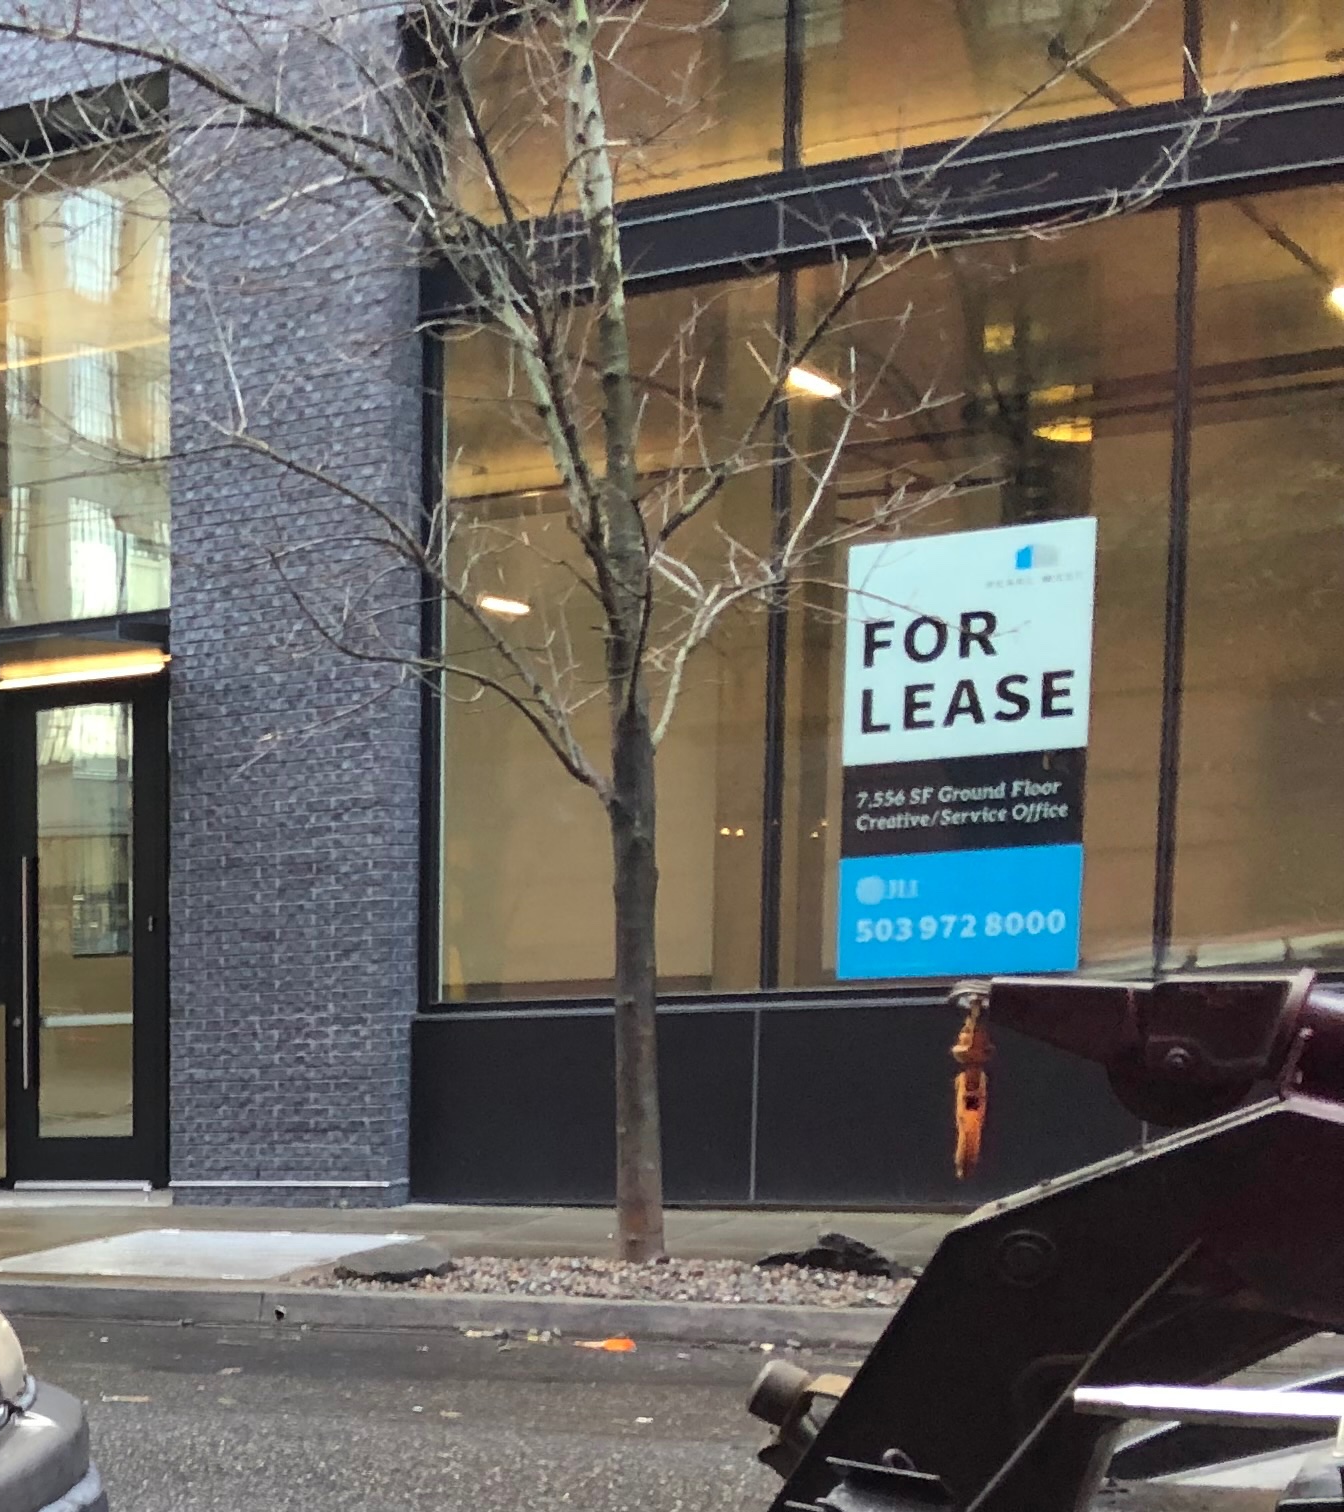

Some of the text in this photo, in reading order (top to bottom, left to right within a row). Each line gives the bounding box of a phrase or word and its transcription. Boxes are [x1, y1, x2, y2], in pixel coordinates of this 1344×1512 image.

[863, 611, 997, 668] FOR
[861, 670, 1075, 734] LEASE
[910, 787, 934, 803] SF
[938, 782, 1006, 803] Ground
[1011, 779, 1062, 797] Floor
[856, 802, 1069, 832] Creative/Service Office
[855, 909, 1067, 943] 503 972 8000
